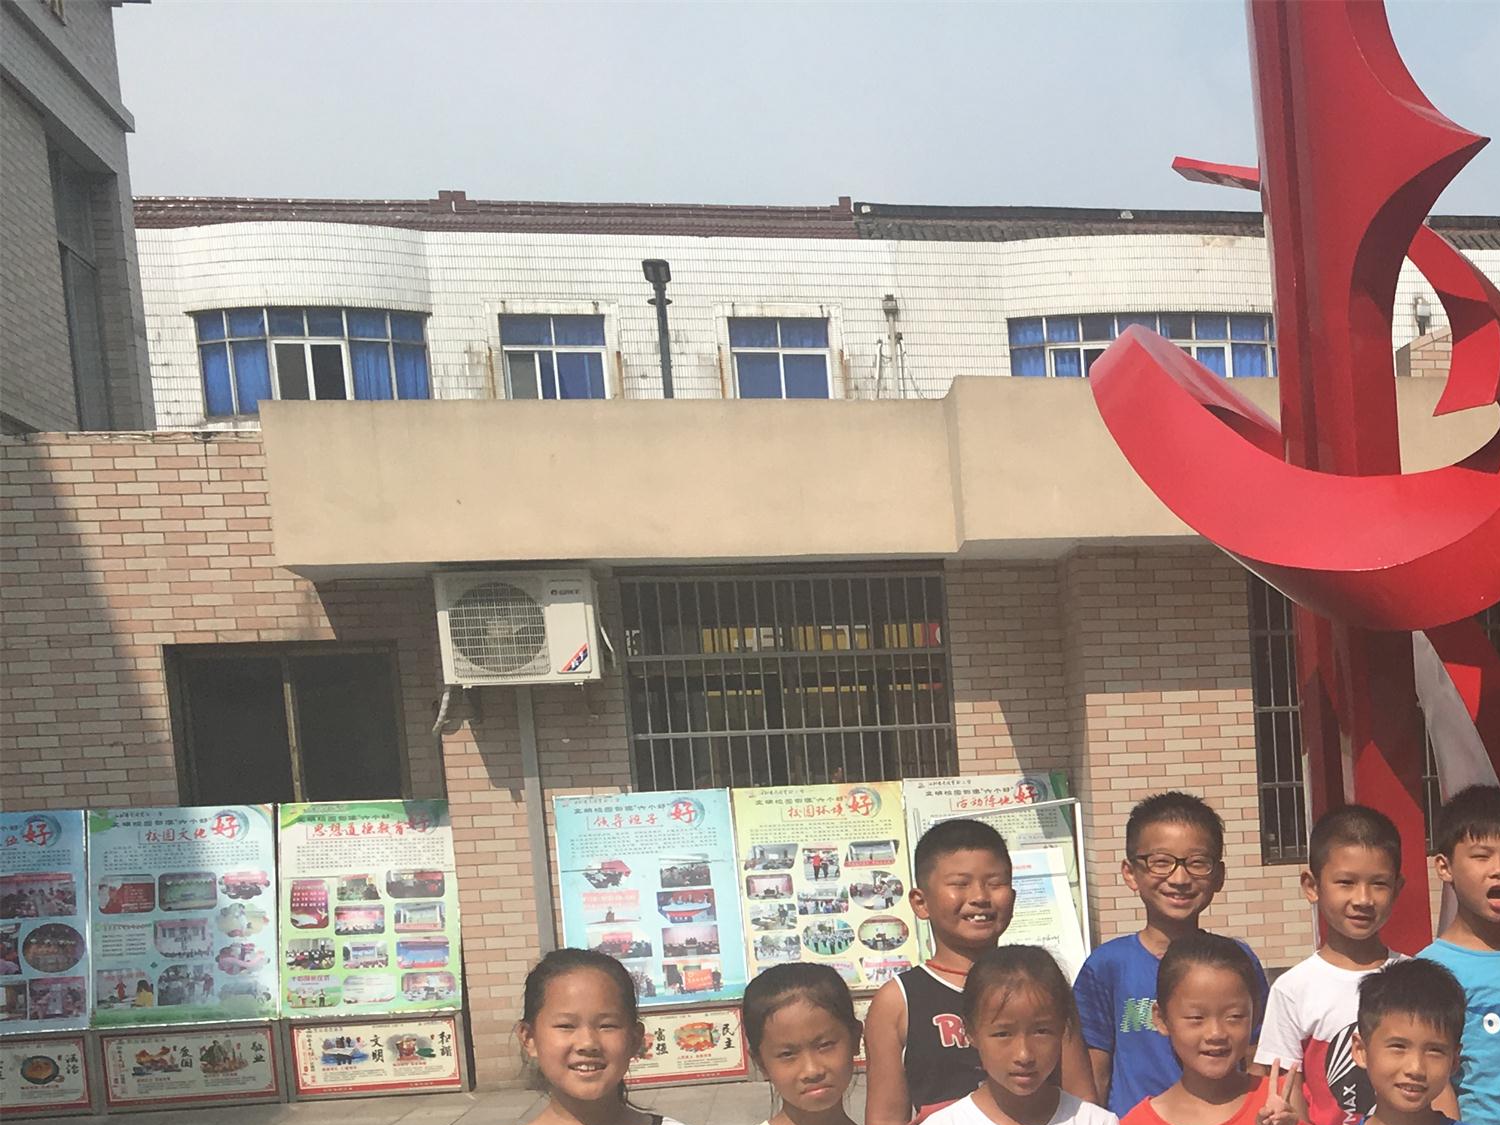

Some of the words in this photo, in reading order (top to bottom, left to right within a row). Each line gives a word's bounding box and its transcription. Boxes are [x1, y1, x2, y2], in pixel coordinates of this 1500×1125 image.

[370, 1034, 384, 1063] 文明
[438, 1031, 452, 1057] 和谐
[654, 1028, 668, 1055] 富强
[722, 1023, 735, 1050] 民主
[180, 1046, 193, 1069] 爱国
